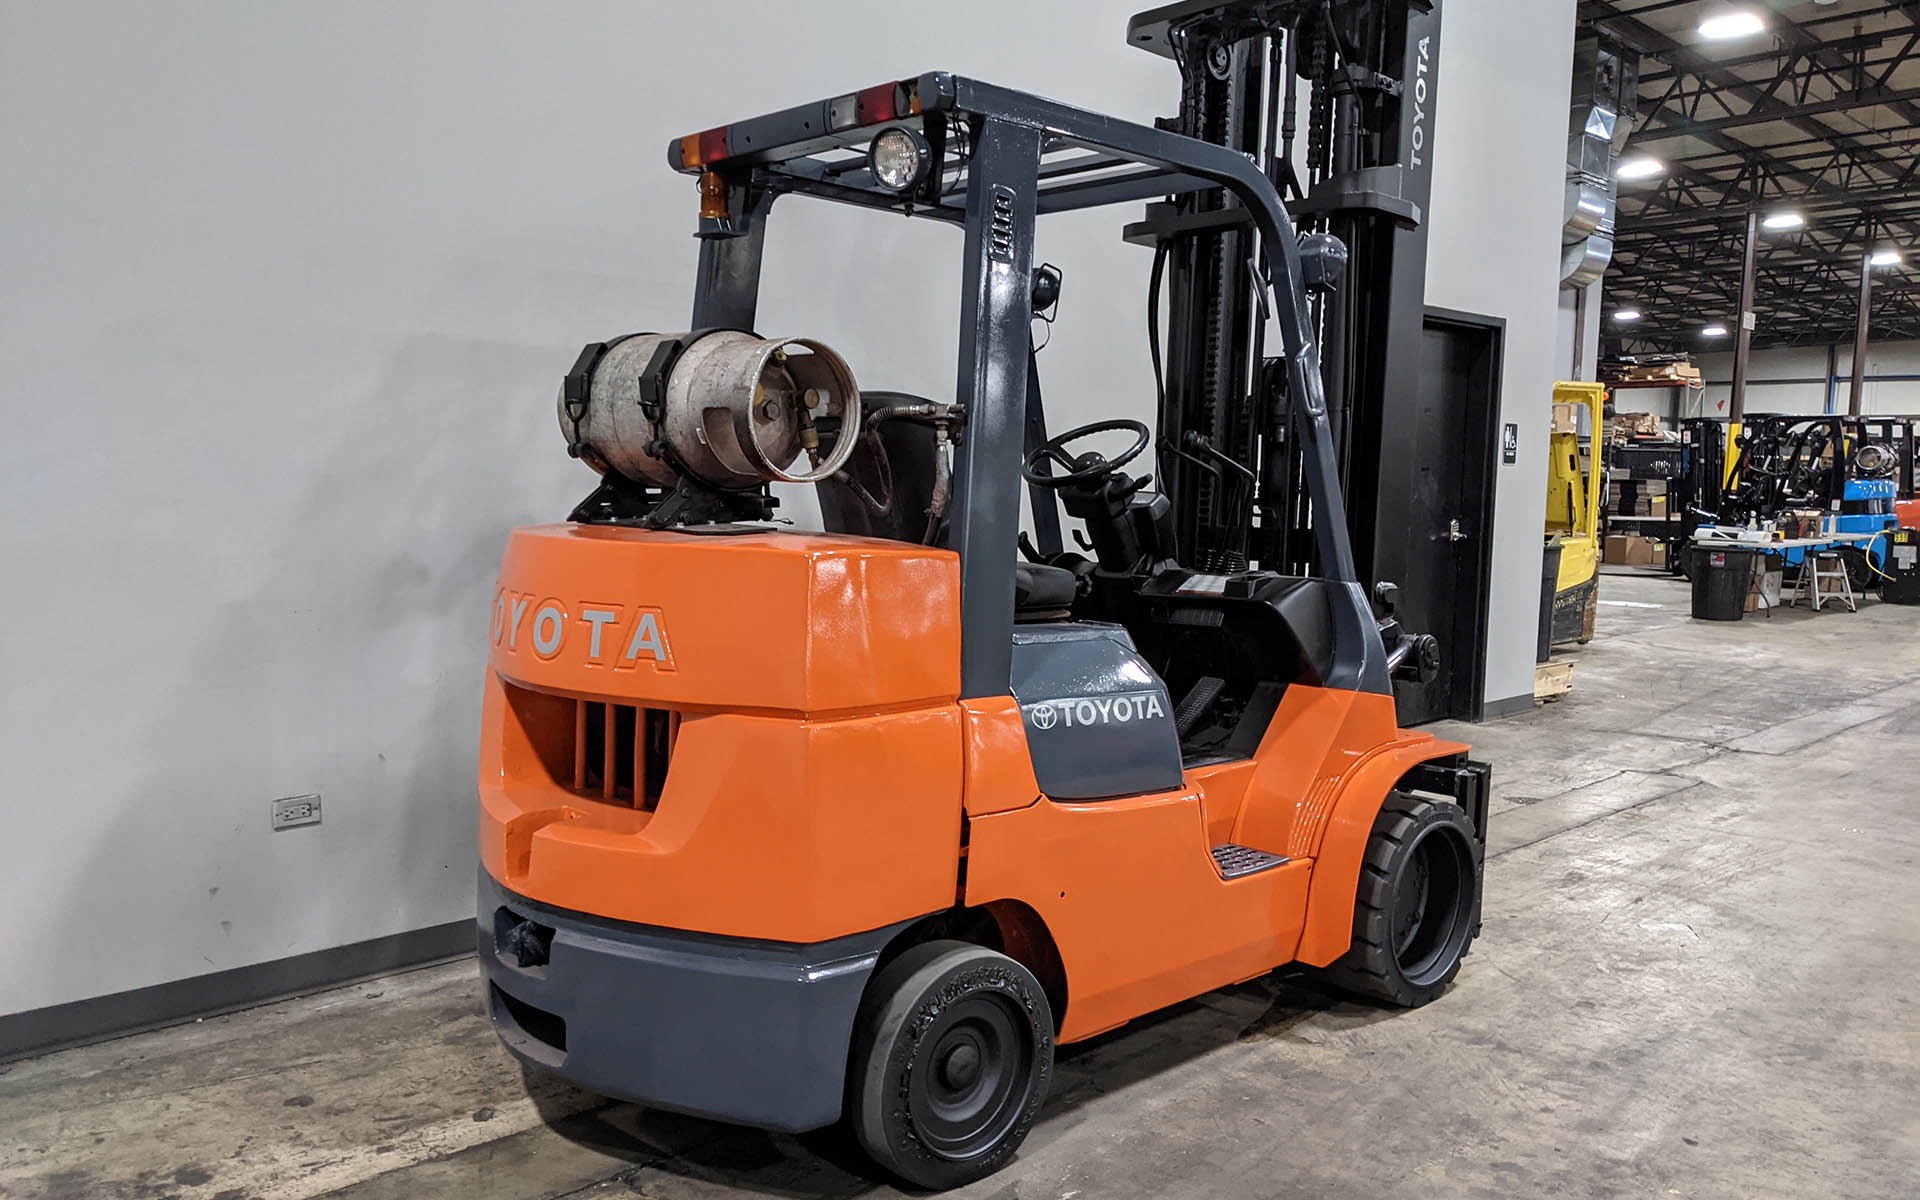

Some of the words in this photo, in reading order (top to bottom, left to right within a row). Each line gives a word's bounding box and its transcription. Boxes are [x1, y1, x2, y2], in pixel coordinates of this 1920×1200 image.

[1410, 36, 1430, 170] TOYOTA
[494, 591, 669, 665] OYOTA
[1058, 695, 1165, 727] TOYOTA
